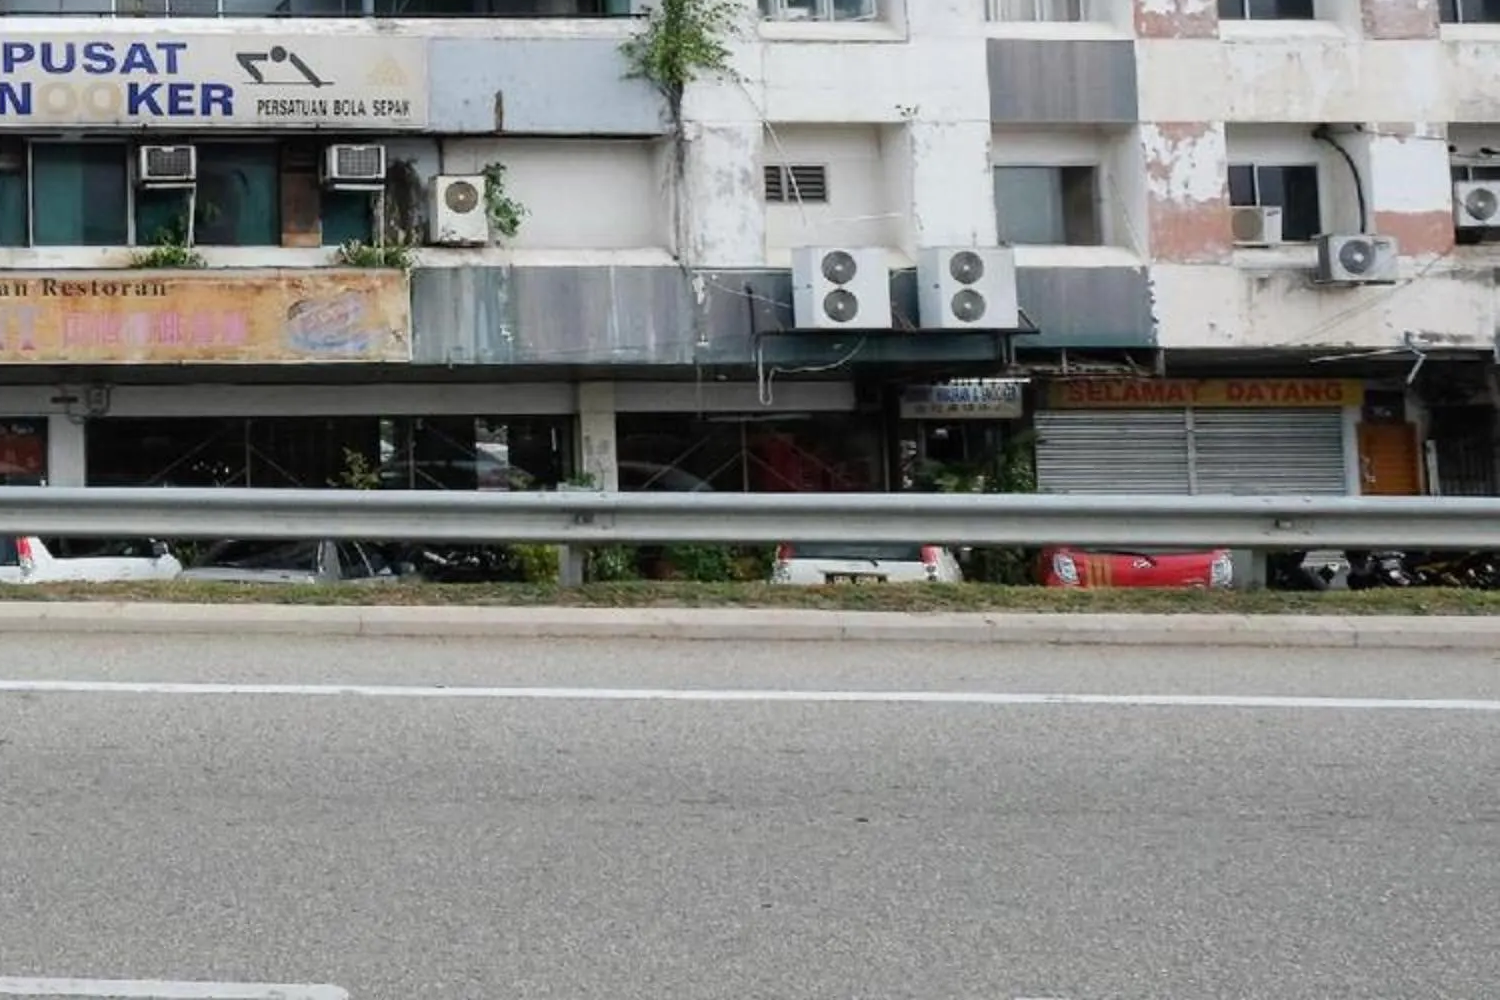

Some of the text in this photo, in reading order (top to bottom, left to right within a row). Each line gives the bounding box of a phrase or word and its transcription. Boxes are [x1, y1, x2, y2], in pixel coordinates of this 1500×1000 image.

[2, 41, 187, 75] PUSAT
[257, 99, 411, 117] PERSATUAN BOLA SEPAK
[41, 278, 169, 297] Restoran
[1067, 380, 1344, 402] SELAMAT DATANG
